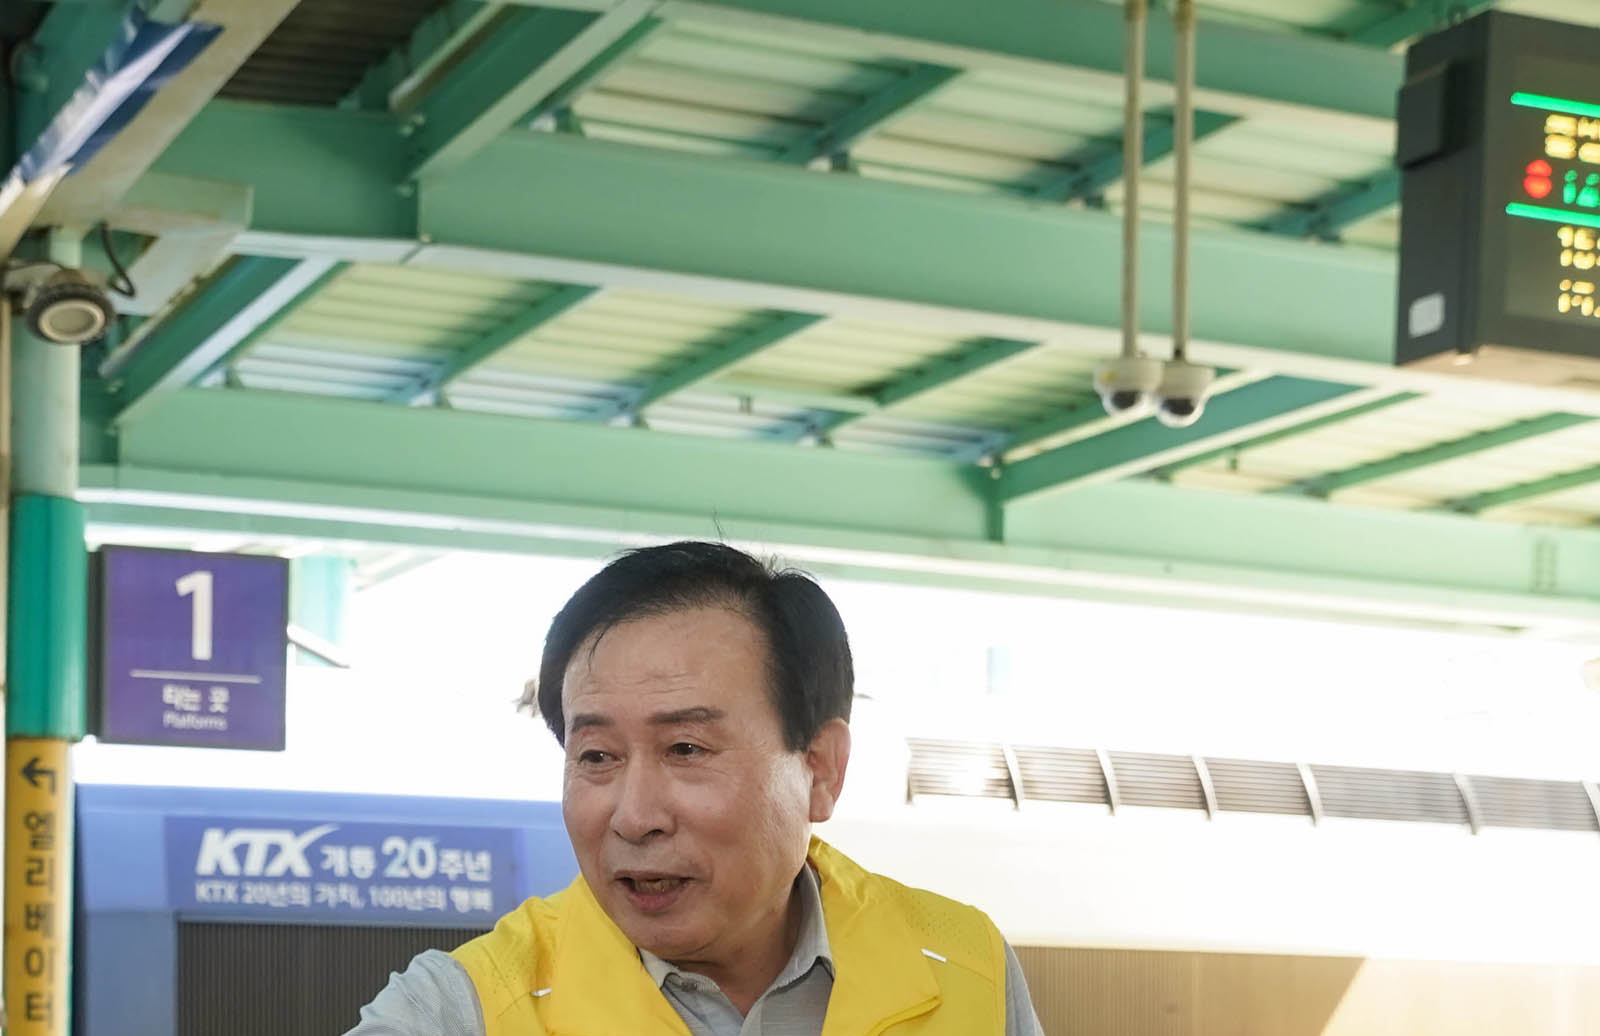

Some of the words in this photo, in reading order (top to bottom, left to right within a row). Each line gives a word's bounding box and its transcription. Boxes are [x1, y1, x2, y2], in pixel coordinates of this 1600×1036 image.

[175, 571, 213, 661] 1
[163, 684, 201, 712] 타는
[208, 686, 230, 713] 곳
[196, 823, 340, 878] KTX
[320, 845, 378, 880] 개통
[381, 835, 493, 882] 20주년
[23, 811, 56, 1031] 엘리베이터
[195, 881, 239, 904] KTX
[240, 882, 312, 908] 20년의
[369, 885, 447, 911] 100년의
